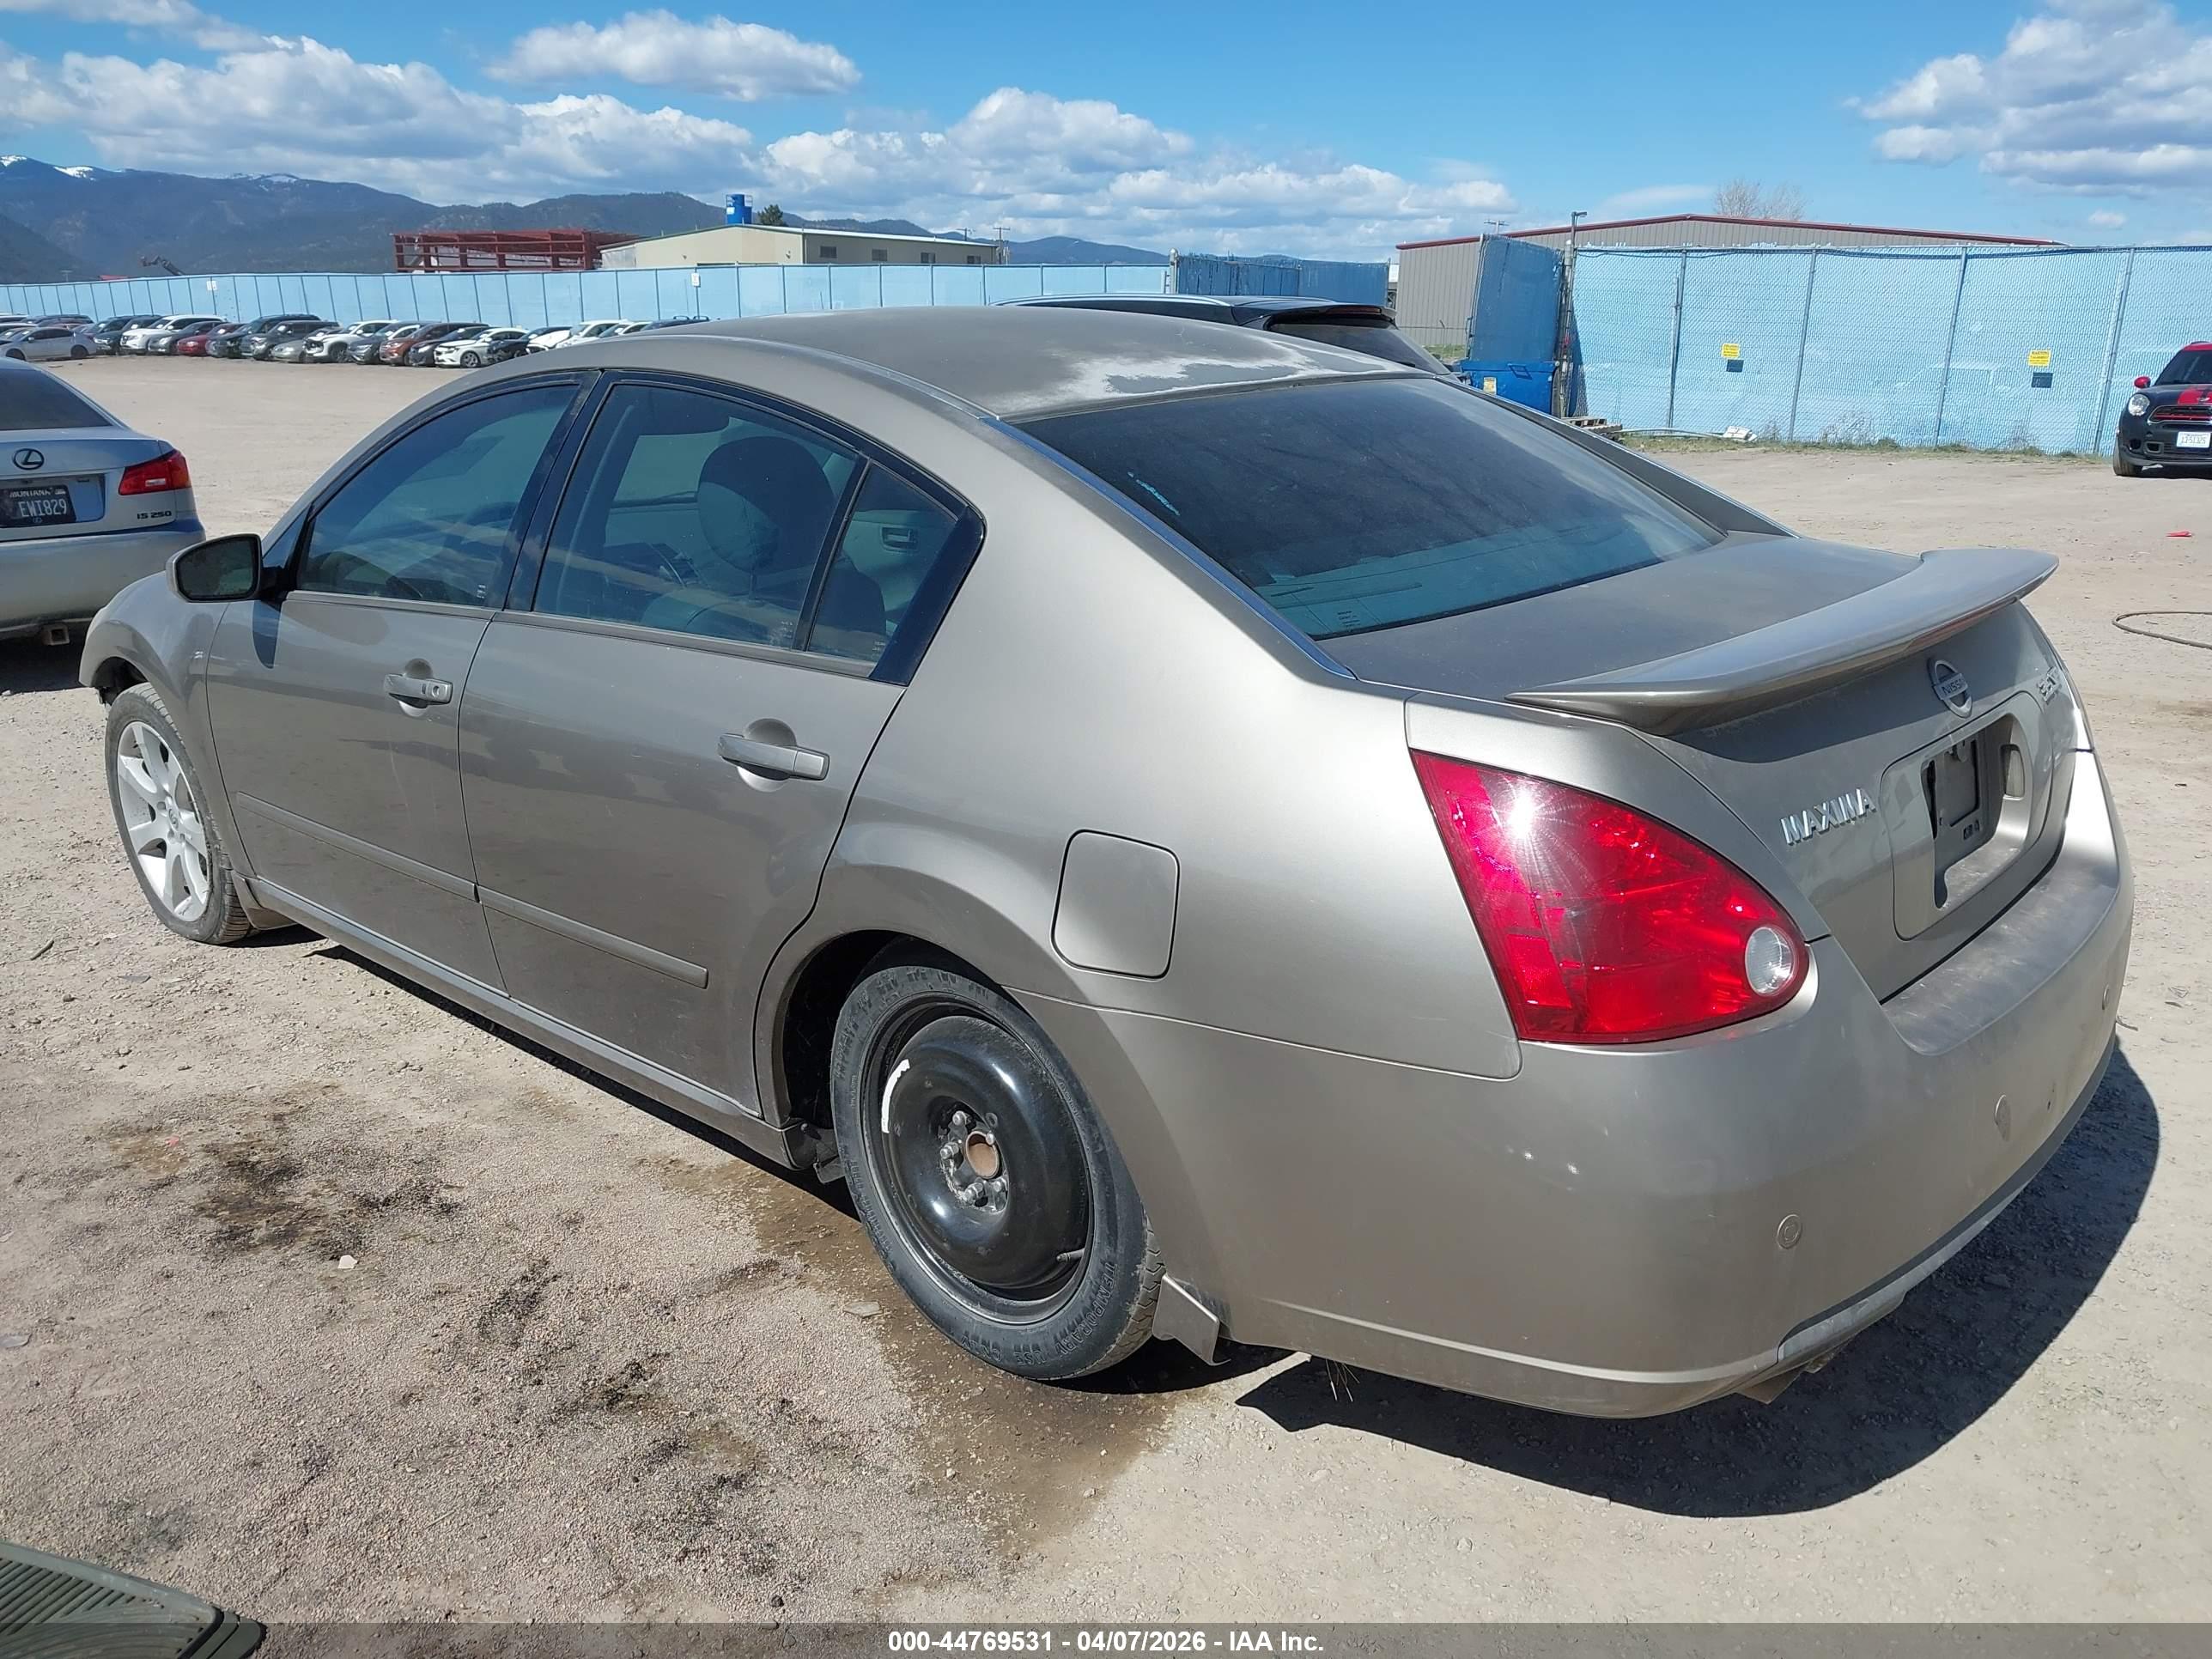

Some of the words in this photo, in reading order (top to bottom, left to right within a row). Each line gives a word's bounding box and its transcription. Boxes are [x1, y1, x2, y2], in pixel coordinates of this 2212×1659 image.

[1781, 788, 1876, 846] MAXIMA
[1054, 1261, 1118, 1355] TEMPORARY
[1014, 1349, 1047, 1365] USE
